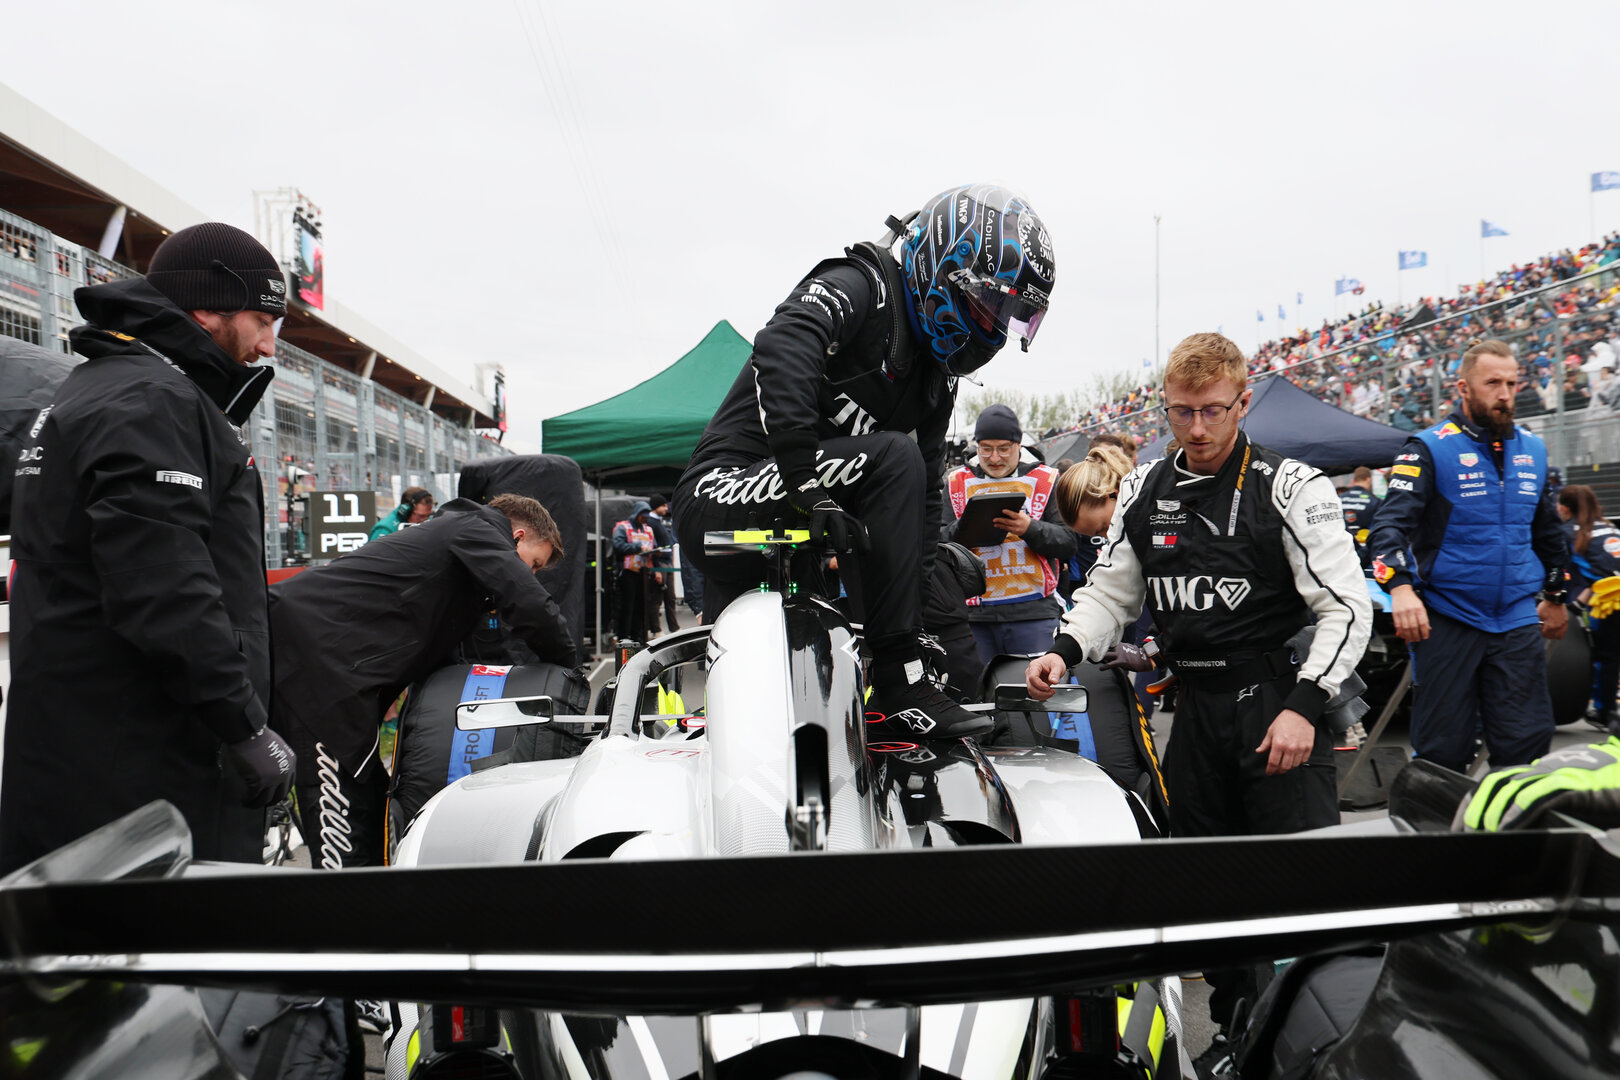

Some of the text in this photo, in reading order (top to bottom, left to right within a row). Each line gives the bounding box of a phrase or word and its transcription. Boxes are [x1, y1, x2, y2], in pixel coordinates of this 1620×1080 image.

[985, 209, 996, 272] CADILLAC
[156, 470, 203, 490] PIRELLI
[323, 493, 366, 523] 11
[1032, 493, 1047, 520] CAN
[321, 533, 369, 553] PER
[1147, 575, 1215, 611] TWG
[464, 729, 481, 764] FRO
